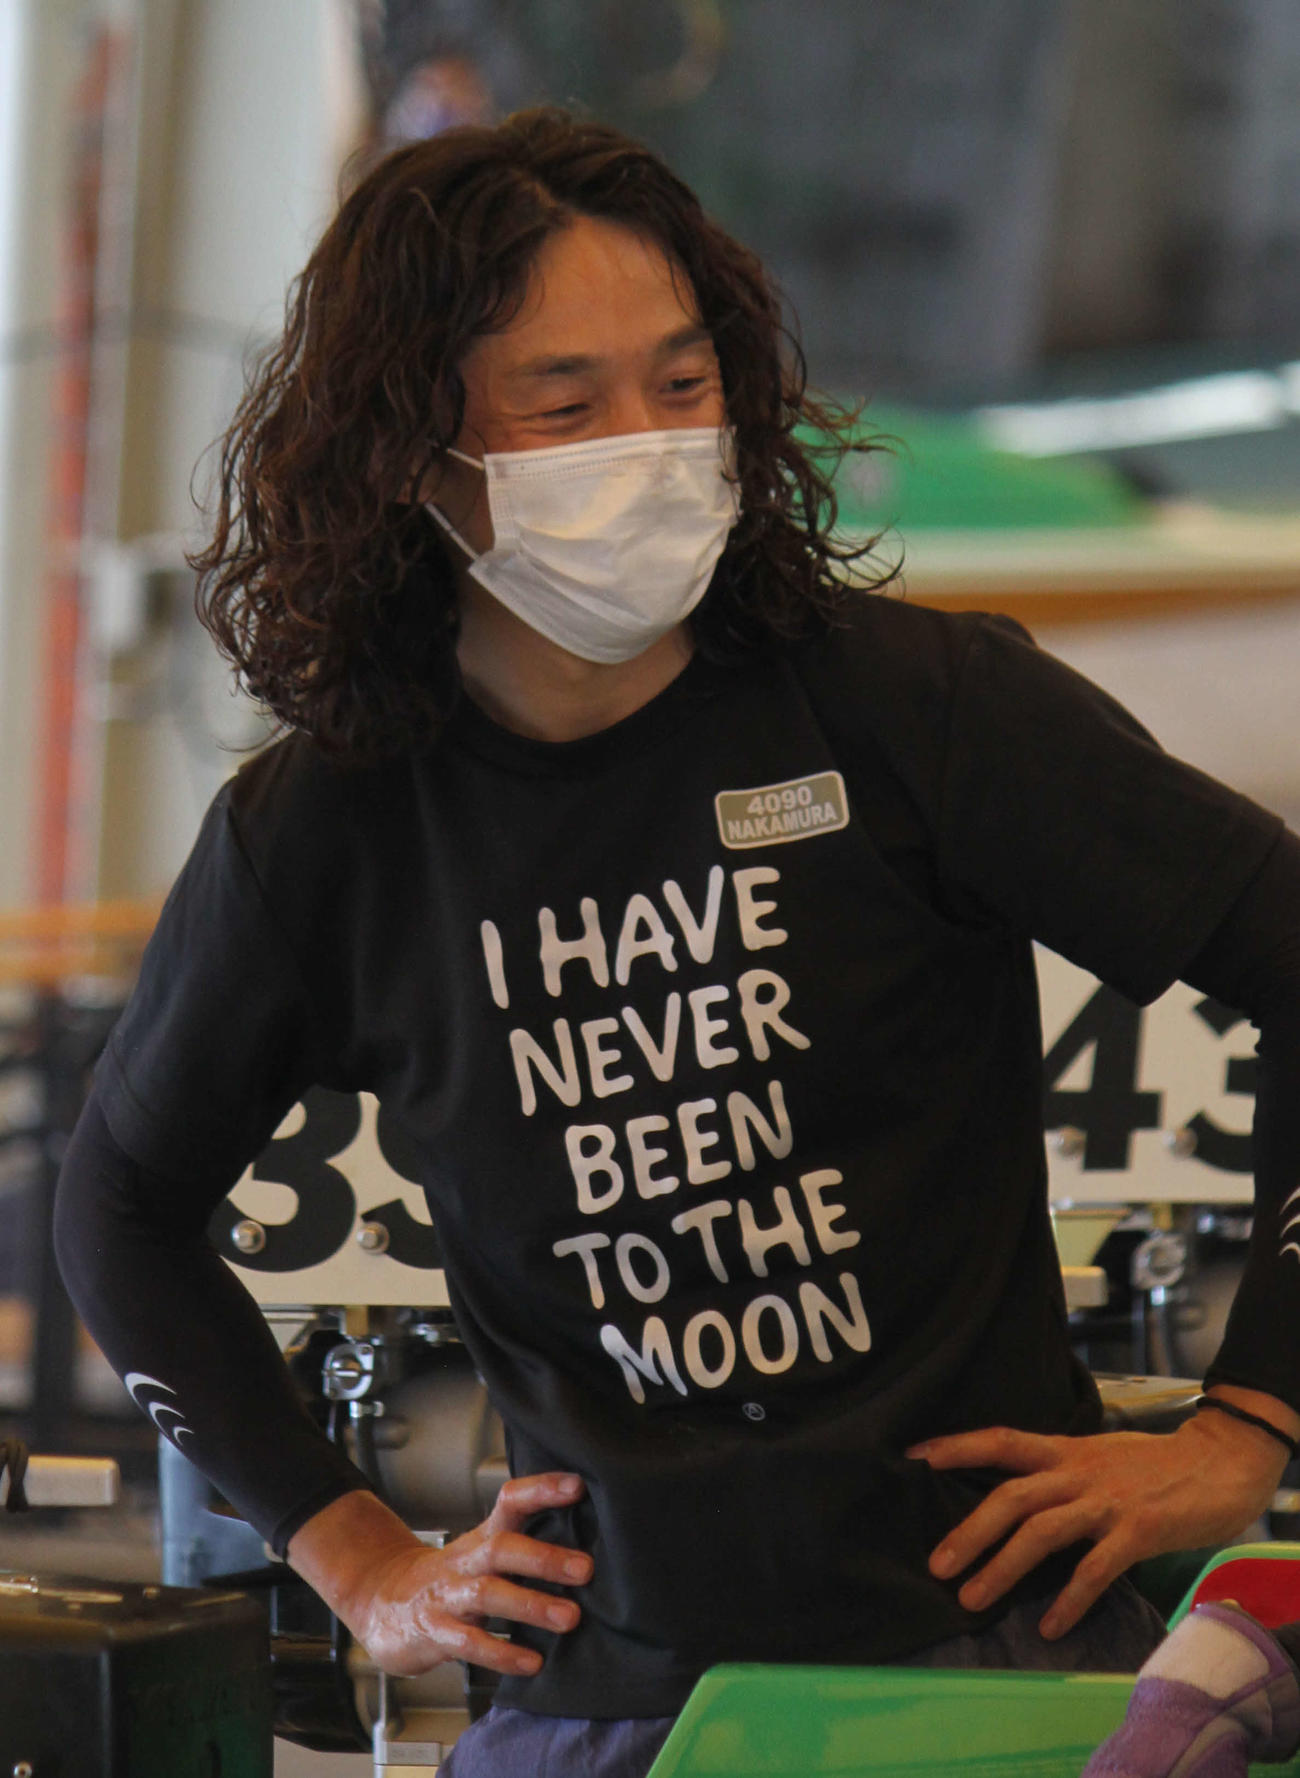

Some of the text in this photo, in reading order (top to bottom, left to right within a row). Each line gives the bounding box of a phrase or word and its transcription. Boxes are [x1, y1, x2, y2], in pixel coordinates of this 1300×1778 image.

[727, 801, 838, 841] NAKAMURA
[747, 785, 813, 815] 4090
[481, 865, 788, 1009] I HAVE
[509, 968, 811, 1116] NEVER
[564, 1080, 793, 1215] BEEN
[552, 1168, 861, 1309] TO THE
[600, 1272, 872, 1404] MOON
